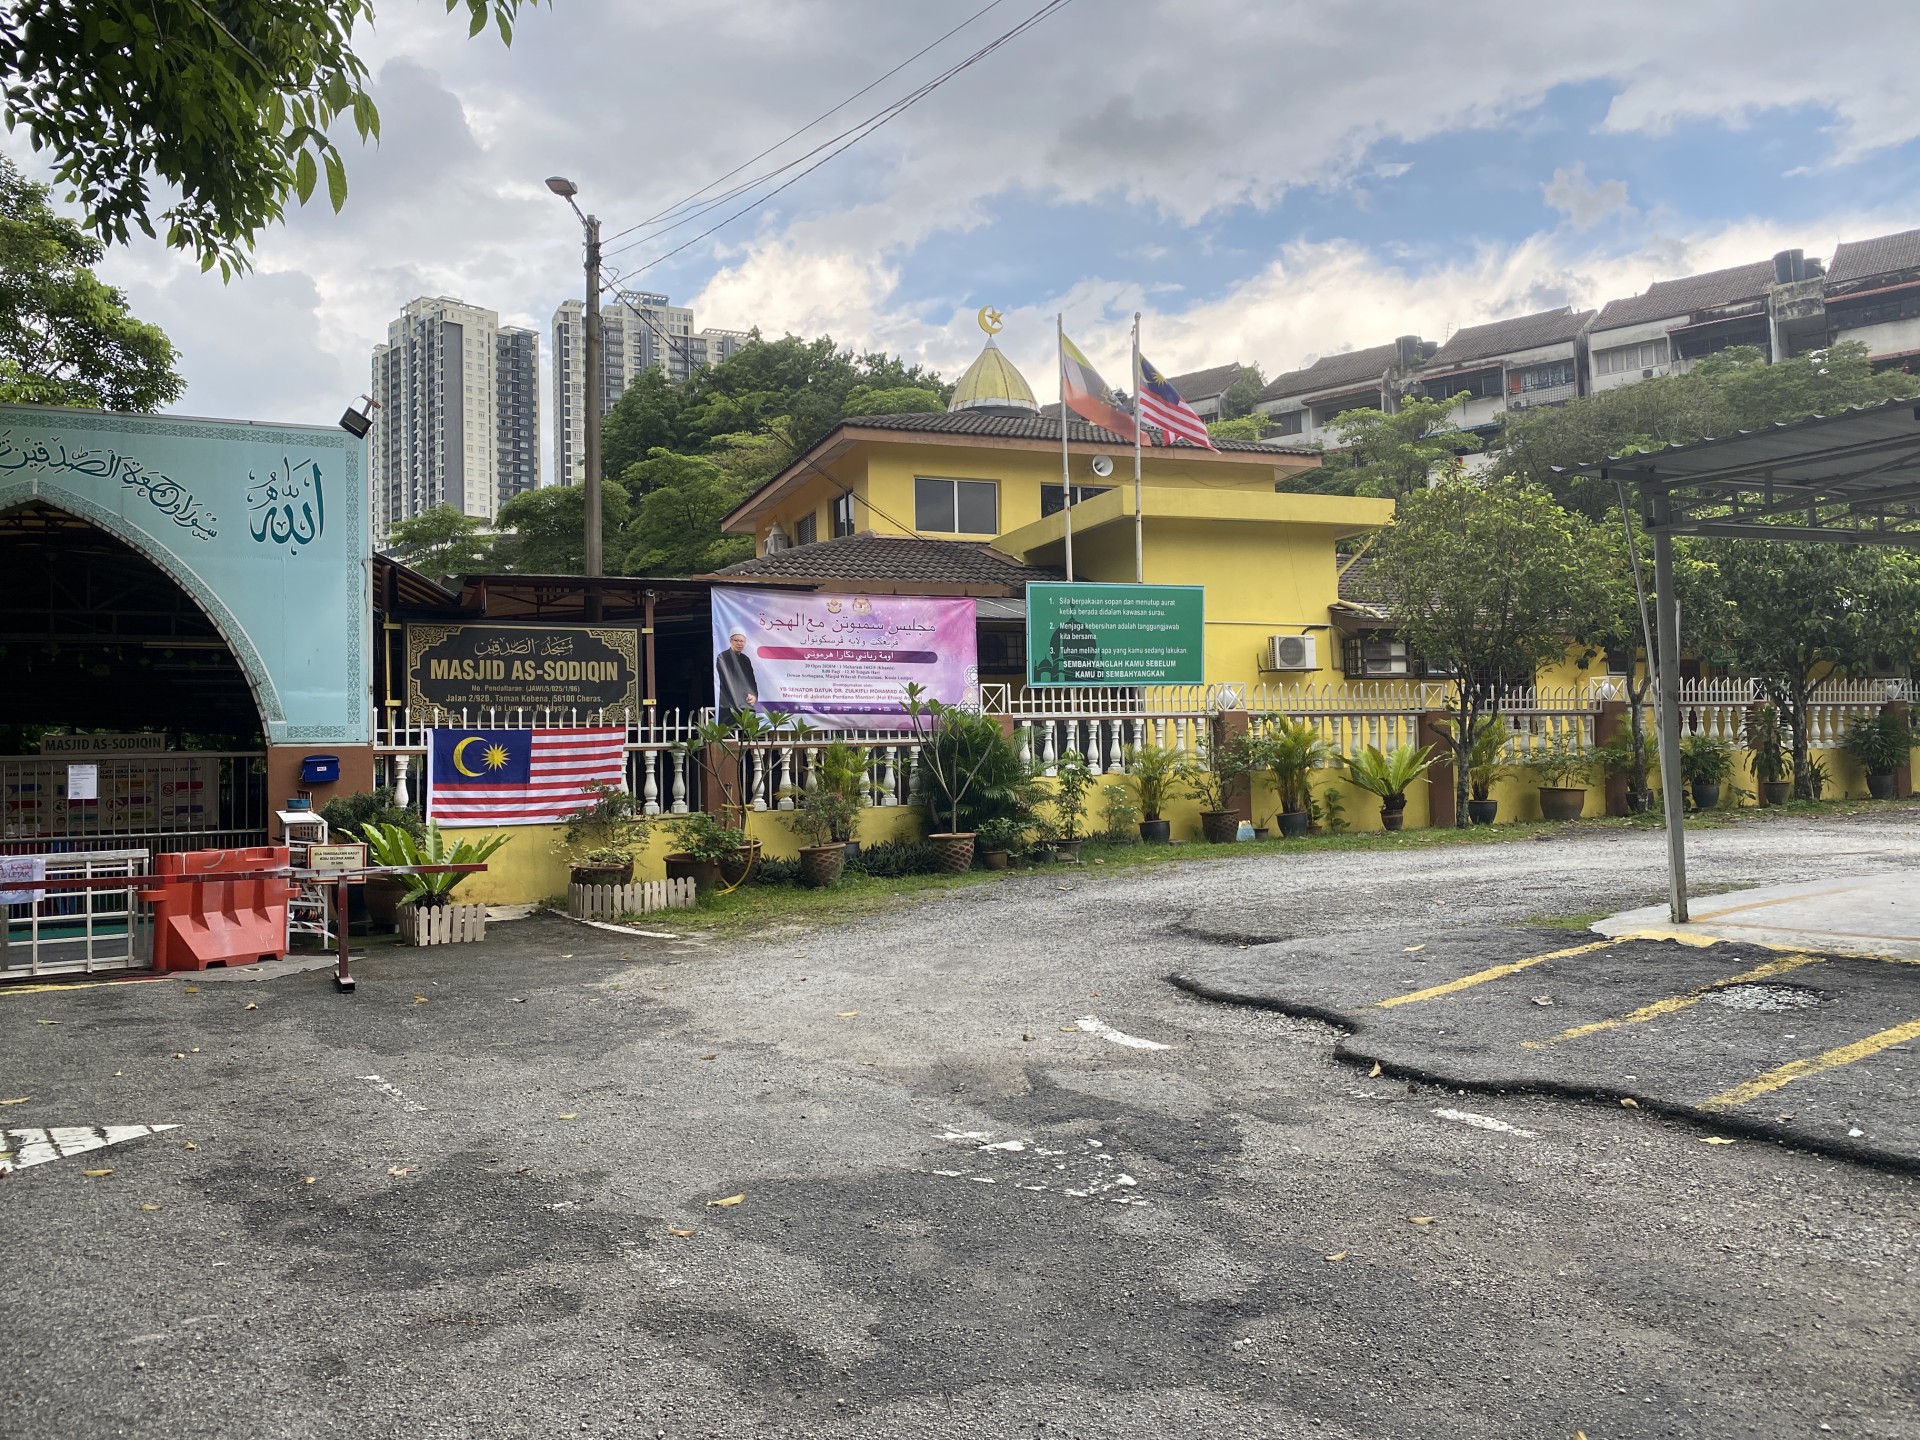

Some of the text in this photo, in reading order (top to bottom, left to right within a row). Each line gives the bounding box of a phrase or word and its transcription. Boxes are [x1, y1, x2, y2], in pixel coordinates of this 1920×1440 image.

[1049, 597, 1055, 605] 1.
[1059, 597, 1071, 605] Sila
[1071, 597, 1104, 606] berpakaian
[1135, 599, 1160, 607] menutup
[1122, 608, 1148, 616] kawasan
[888, 617, 936, 636] مجليس
[1049, 622, 1180, 632] 2. Menjaga kebersihan adalah tanggungjawab
[1059, 632, 1071, 640] kita
[1049, 646, 1056, 655] 3.
[1060, 646, 1078, 655] Tuhan
[1078, 647, 1101, 655] melihat
[1101, 648, 1112, 656] apa
[1112, 648, 1127, 656] yang
[1144, 647, 1165, 656] sedang
[1063, 660, 1177, 668] SEMBAHYANGLAH KAMU SEBELUM
[430, 658, 619, 683] MASJID AS-SODIQIN
[1075, 670, 1165, 679] KAMU DI SEMBAHYANGKAN
[471, 684, 483, 692] No.
[446, 694, 467, 702] Jalan
[468, 694, 493, 703] 2/92B,
[495, 694, 520, 702] Taman
[521, 695, 551, 703] Kobena,
[576, 695, 604, 703] Cheras,
[481, 704, 502, 712] Kula
[45, 737, 161, 751] MASJID AS-SODIQIN
